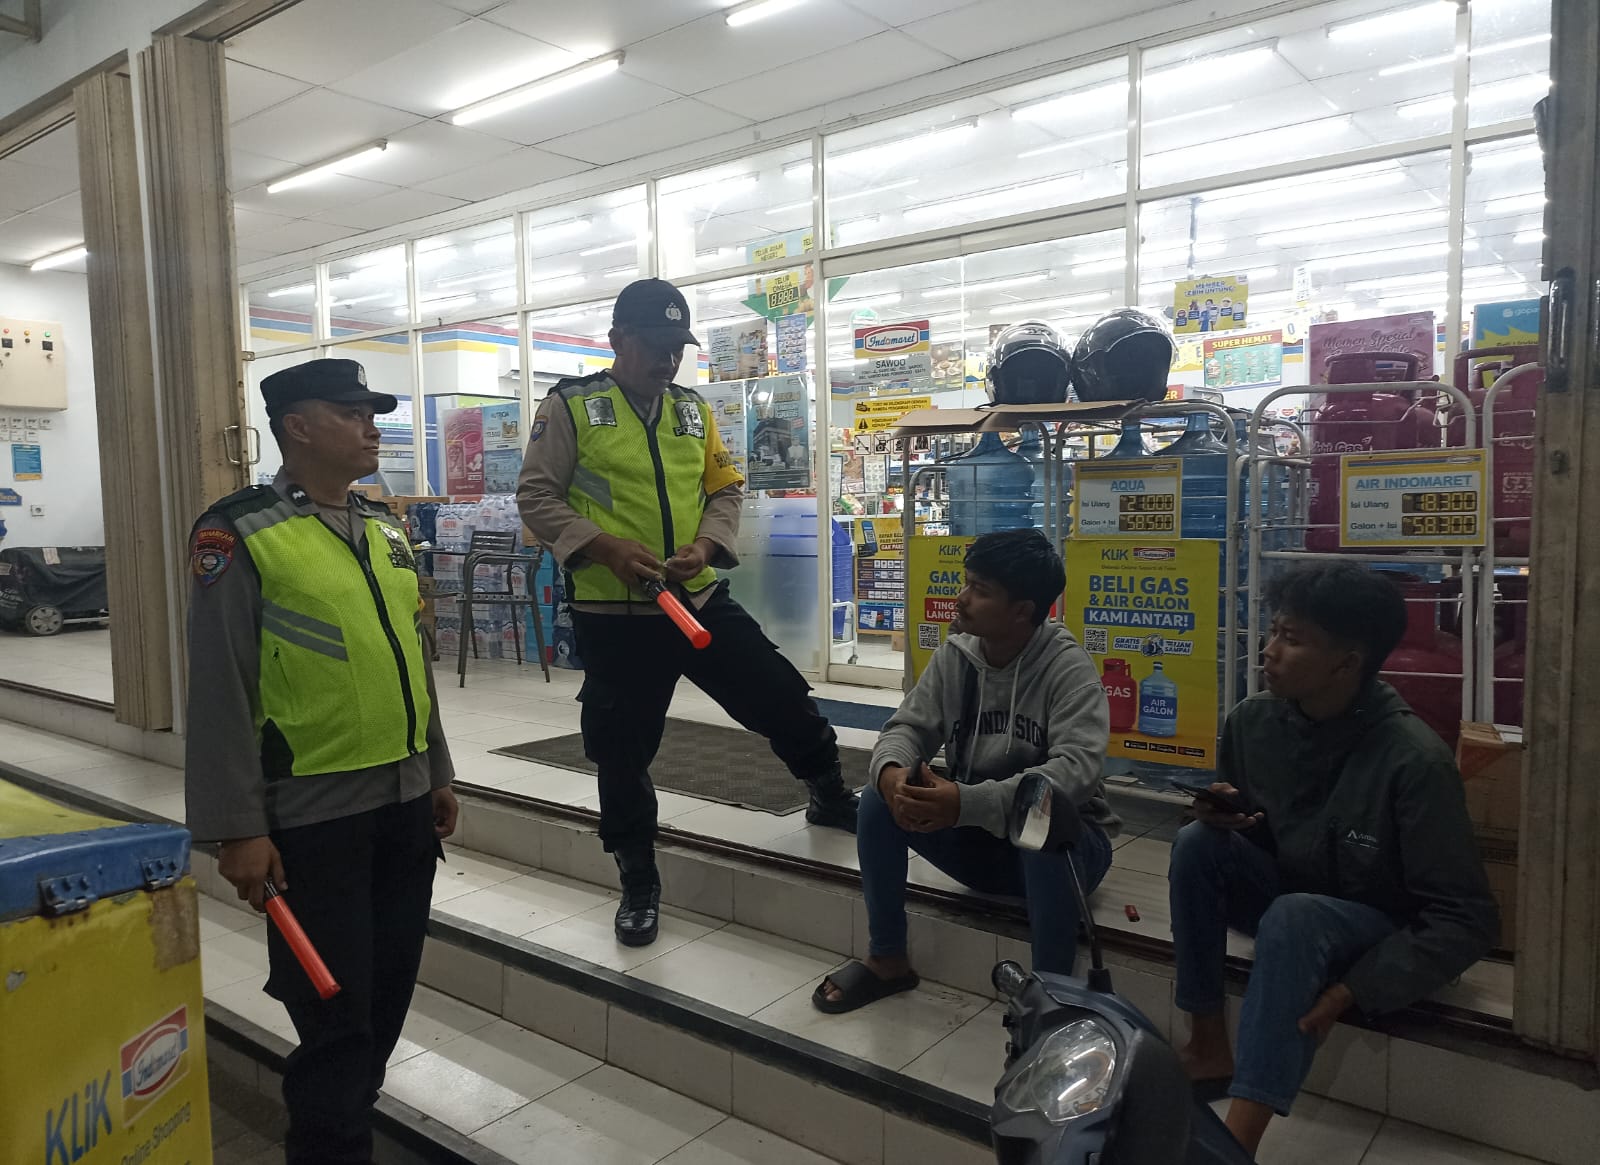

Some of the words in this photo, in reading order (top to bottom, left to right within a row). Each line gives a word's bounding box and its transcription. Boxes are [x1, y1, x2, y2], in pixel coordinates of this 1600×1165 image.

[868, 332, 915, 347] Indomaret
[1212, 340, 1241, 349] SUPER
[1241, 334, 1273, 345] HEMAT
[876, 359, 906, 369] SAWOO
[1111, 480, 1145, 491] AQUA
[1356, 479, 1380, 489] AIR
[1385, 474, 1473, 489] INDOMARET
[1091, 501, 1111, 509] Ulang
[1363, 501, 1389, 509] Ulang
[1350, 522, 1376, 530] Galon
[1387, 521, 1398, 529] Isi
[930, 570, 962, 585] GAK
[1089, 575, 1135, 594] BELI
[1140, 577, 1189, 596] GAS
[1089, 593, 1099, 606] &
[1102, 595, 1129, 608] AIR
[1132, 596, 1190, 610] GALON
[926, 610, 960, 620] LANGS
[1089, 610, 1128, 624] KAMI
[1130, 612, 1189, 627] ANTAR!
[1115, 637, 1140, 645] GRATIS
[1104, 685, 1132, 698] GAS
[1150, 699, 1166, 707] AIR
[1142, 705, 1174, 716] GALON
[45, 1069, 112, 1165] KLiK
